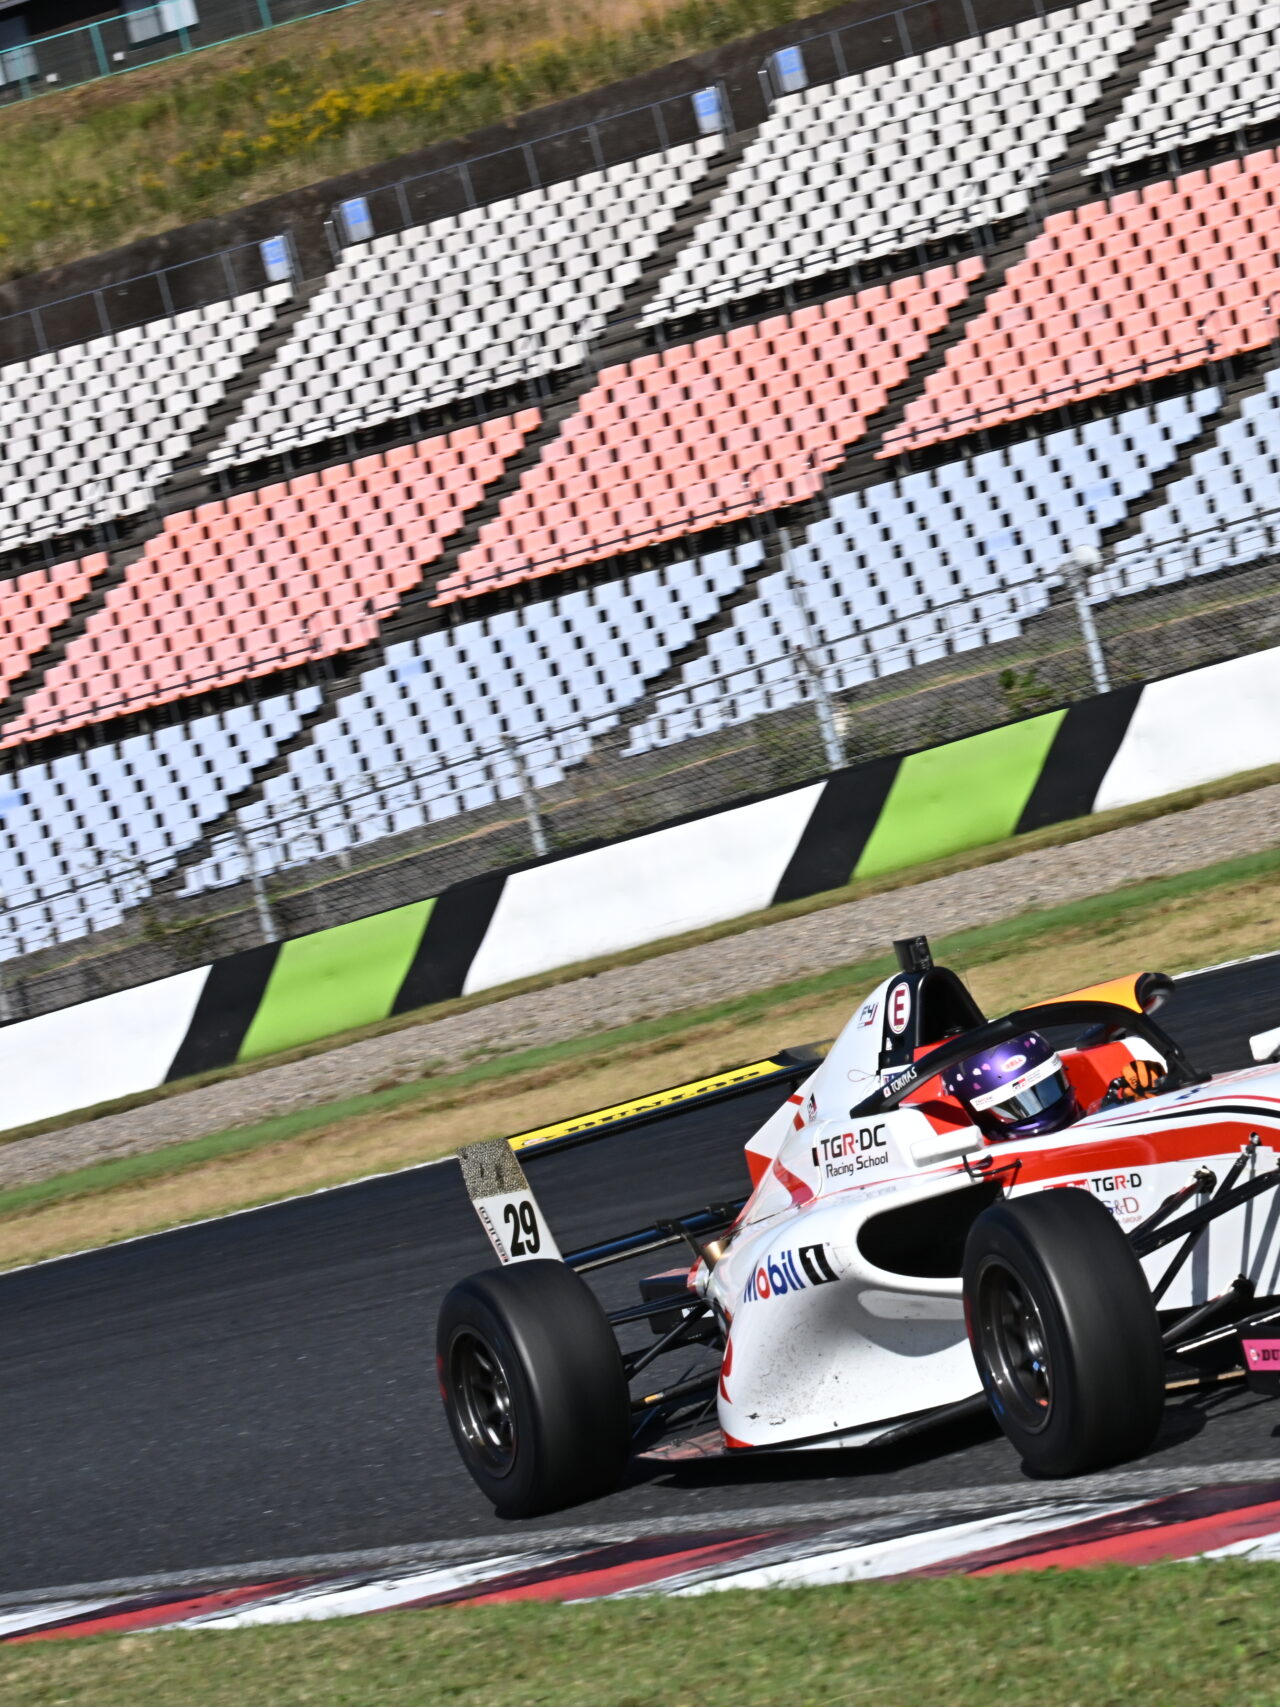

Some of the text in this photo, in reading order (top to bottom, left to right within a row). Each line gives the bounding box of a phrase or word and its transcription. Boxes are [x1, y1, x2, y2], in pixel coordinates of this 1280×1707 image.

[893, 989, 906, 1027] E
[826, 1152, 889, 1178] Racing School
[503, 1200, 540, 1257] 29
[744, 1250, 806, 1303] Mobil
